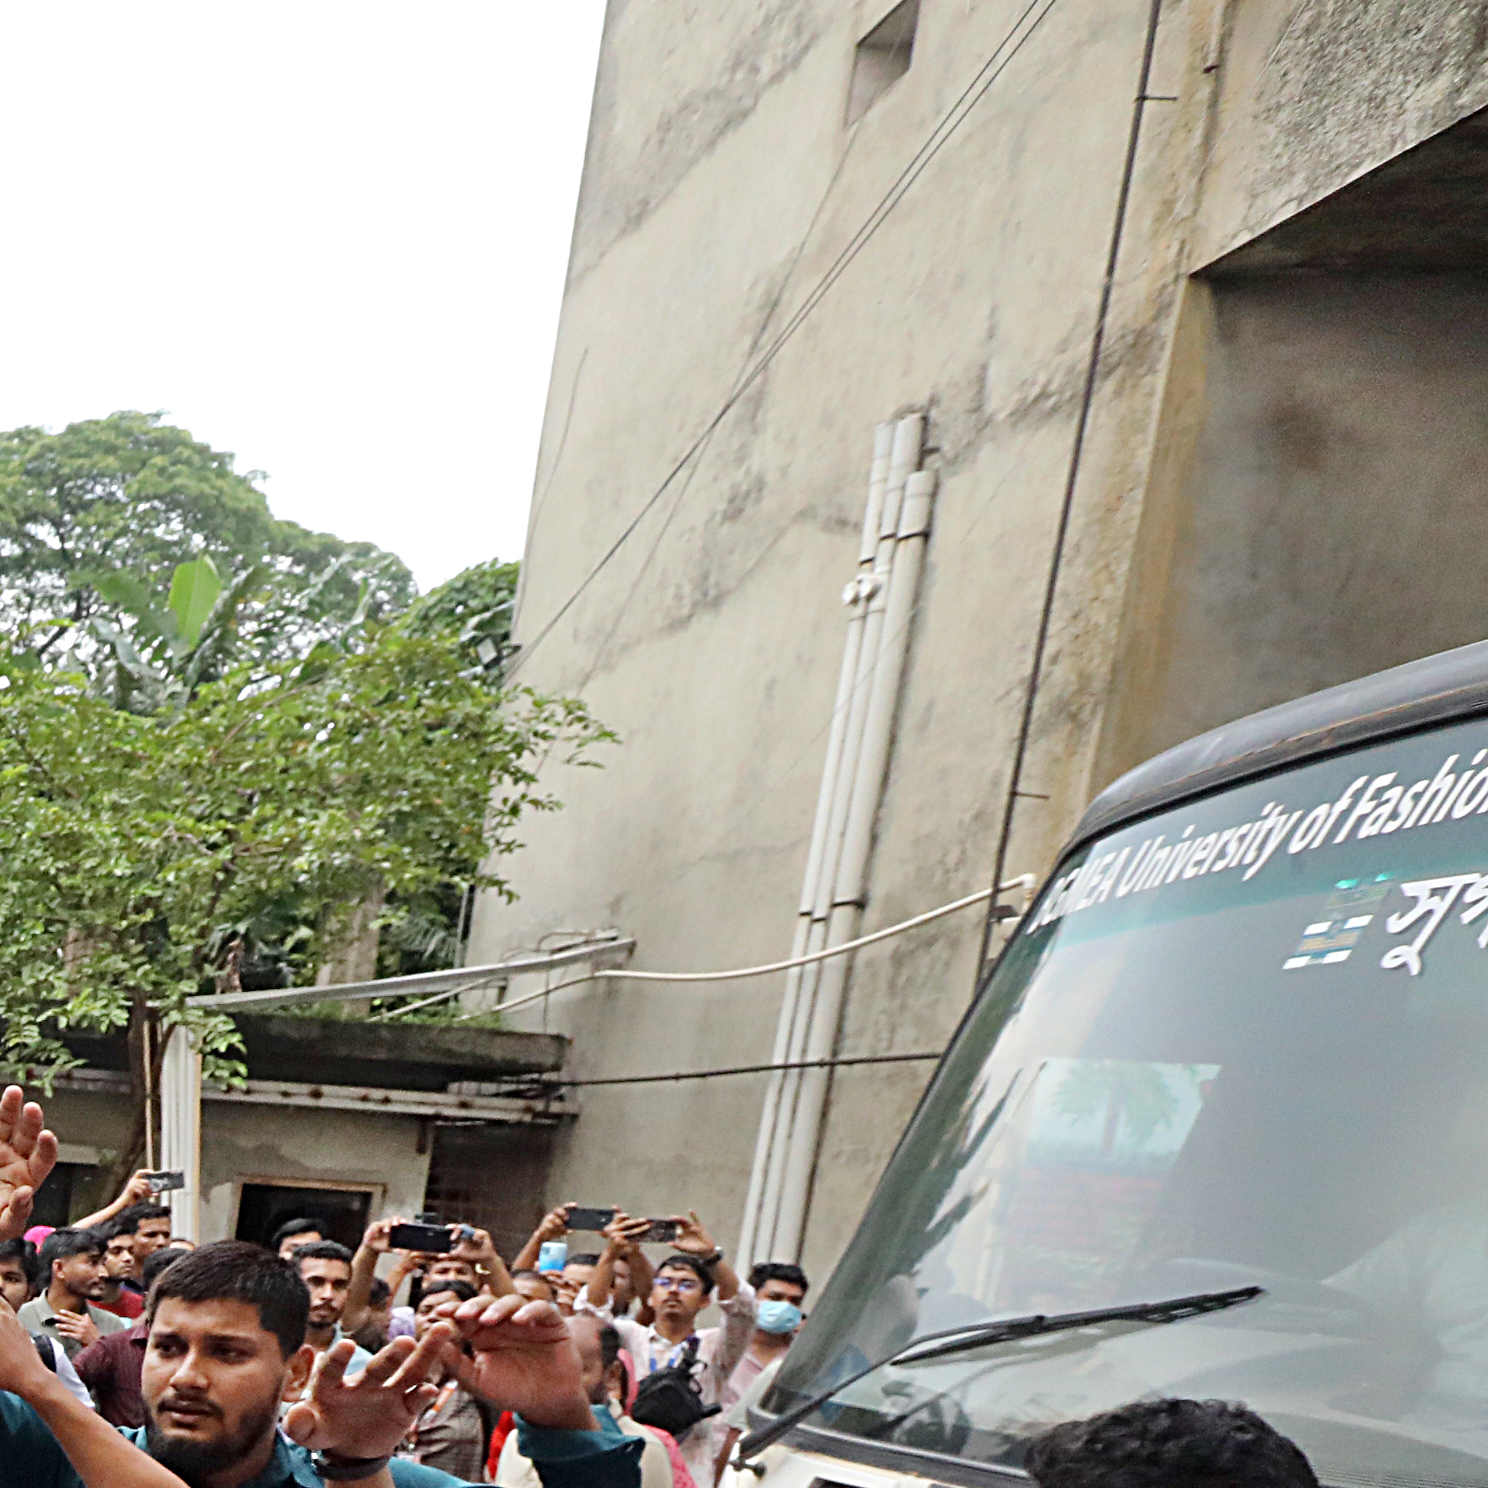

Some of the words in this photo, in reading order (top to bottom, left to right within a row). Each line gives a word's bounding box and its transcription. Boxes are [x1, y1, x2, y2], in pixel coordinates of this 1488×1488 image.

[1116, 801, 1307, 882] University
[1287, 775, 1369, 854] of
[1332, 749, 1488, 844] Fashio
